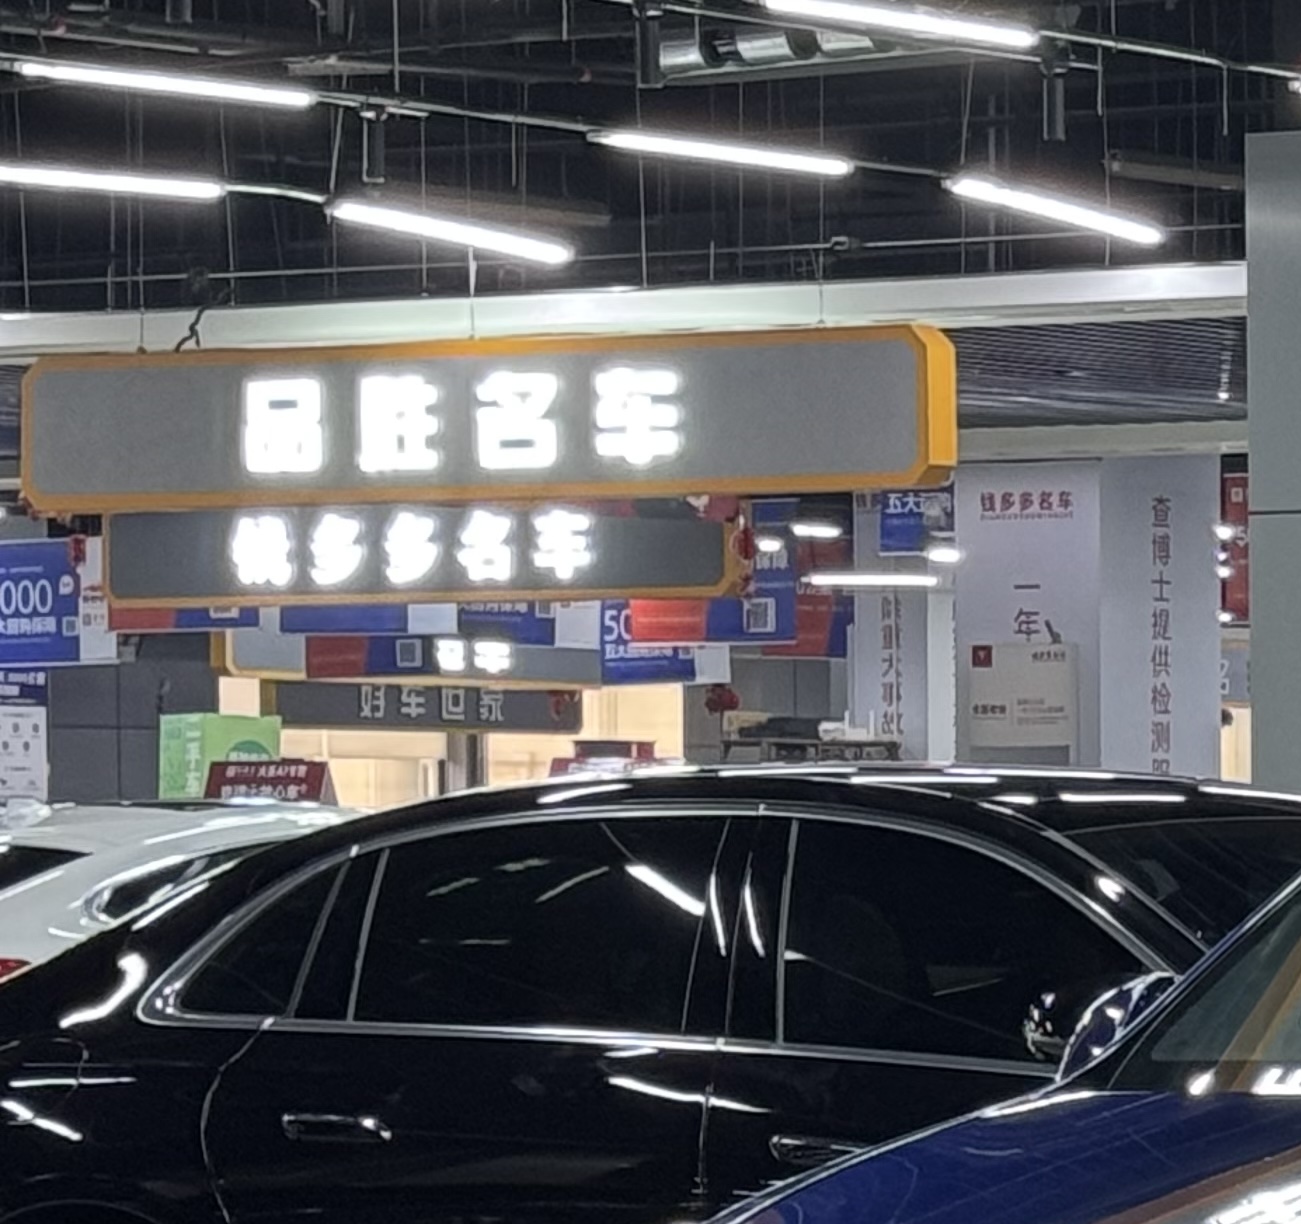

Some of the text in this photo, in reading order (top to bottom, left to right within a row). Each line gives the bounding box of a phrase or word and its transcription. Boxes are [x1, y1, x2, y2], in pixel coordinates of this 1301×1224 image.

[243, 367, 683, 474] 品胜名车
[981, 490, 1073, 513] 钱多多名车
[230, 508, 593, 587] 钱多多名车
